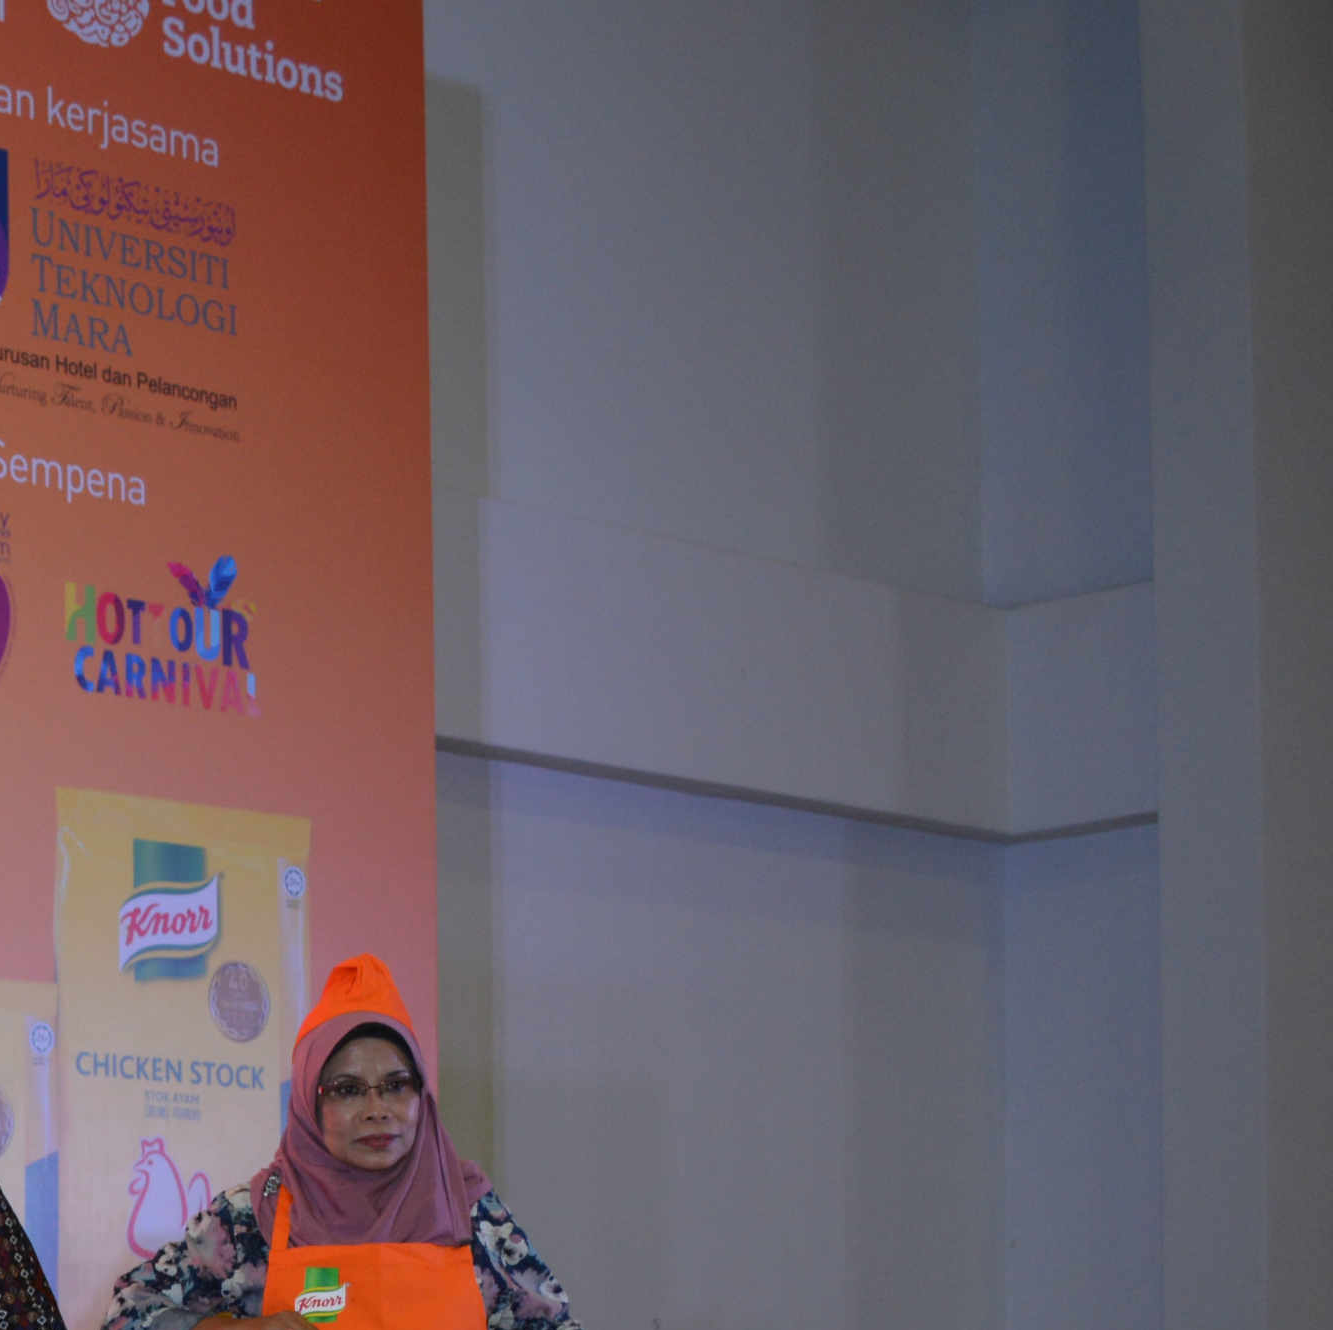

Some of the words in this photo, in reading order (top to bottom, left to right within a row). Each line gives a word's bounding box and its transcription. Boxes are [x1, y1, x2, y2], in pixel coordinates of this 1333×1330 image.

[163, 0, 256, 30] ood
[162, 18, 344, 102] Solutions
[46, 86, 220, 167] kerjasama
[30, 207, 231, 289] UNIVERSITI
[30, 253, 238, 335] TEKNOLOGI
[30, 300, 133, 356] MARA
[55, 354, 97, 380] Hotel
[102, 366, 132, 388] dan
[137, 371, 238, 411] Pelancongan
[122, 903, 213, 946] Knorr
[75, 1051, 183, 1085] CHICKEN
[190, 1060, 265, 1091] STOCK
[298, 1294, 346, 1313] Knorr
